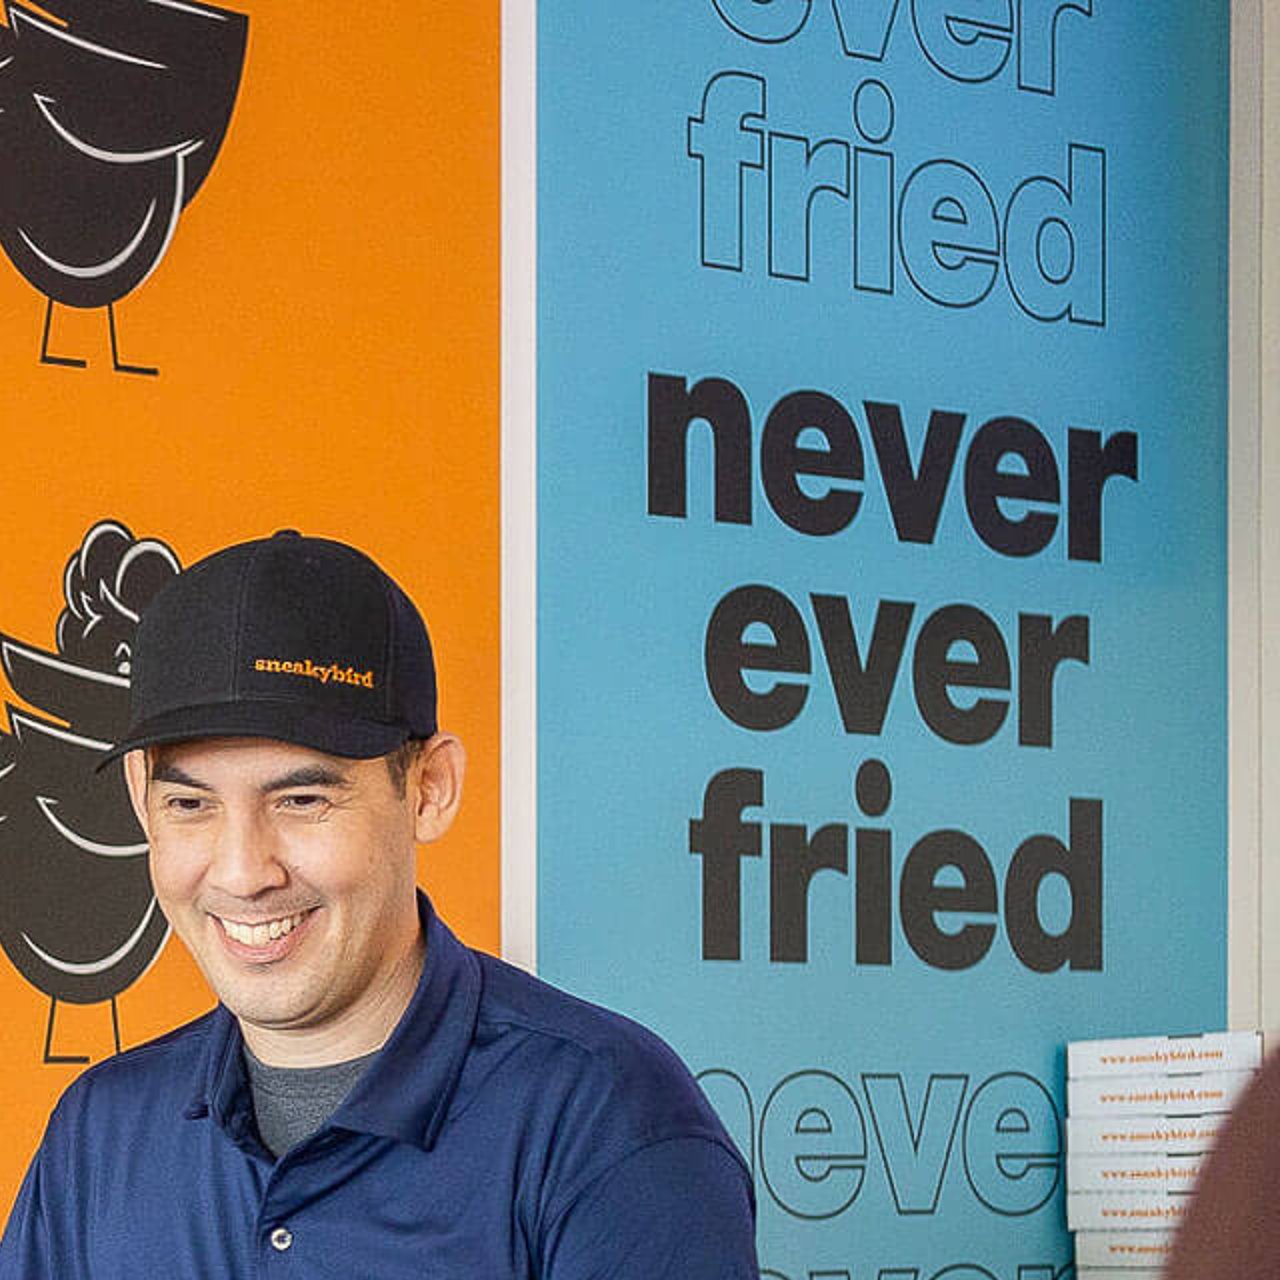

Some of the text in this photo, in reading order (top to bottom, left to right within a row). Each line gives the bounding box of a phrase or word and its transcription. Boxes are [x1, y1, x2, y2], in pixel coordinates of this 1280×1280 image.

[687, 70, 1105, 327] fried
[648, 371, 1139, 563] never
[254, 659, 374, 688] sneakybird
[705, 583, 1090, 748] ever
[689, 758, 1104, 973] fried
